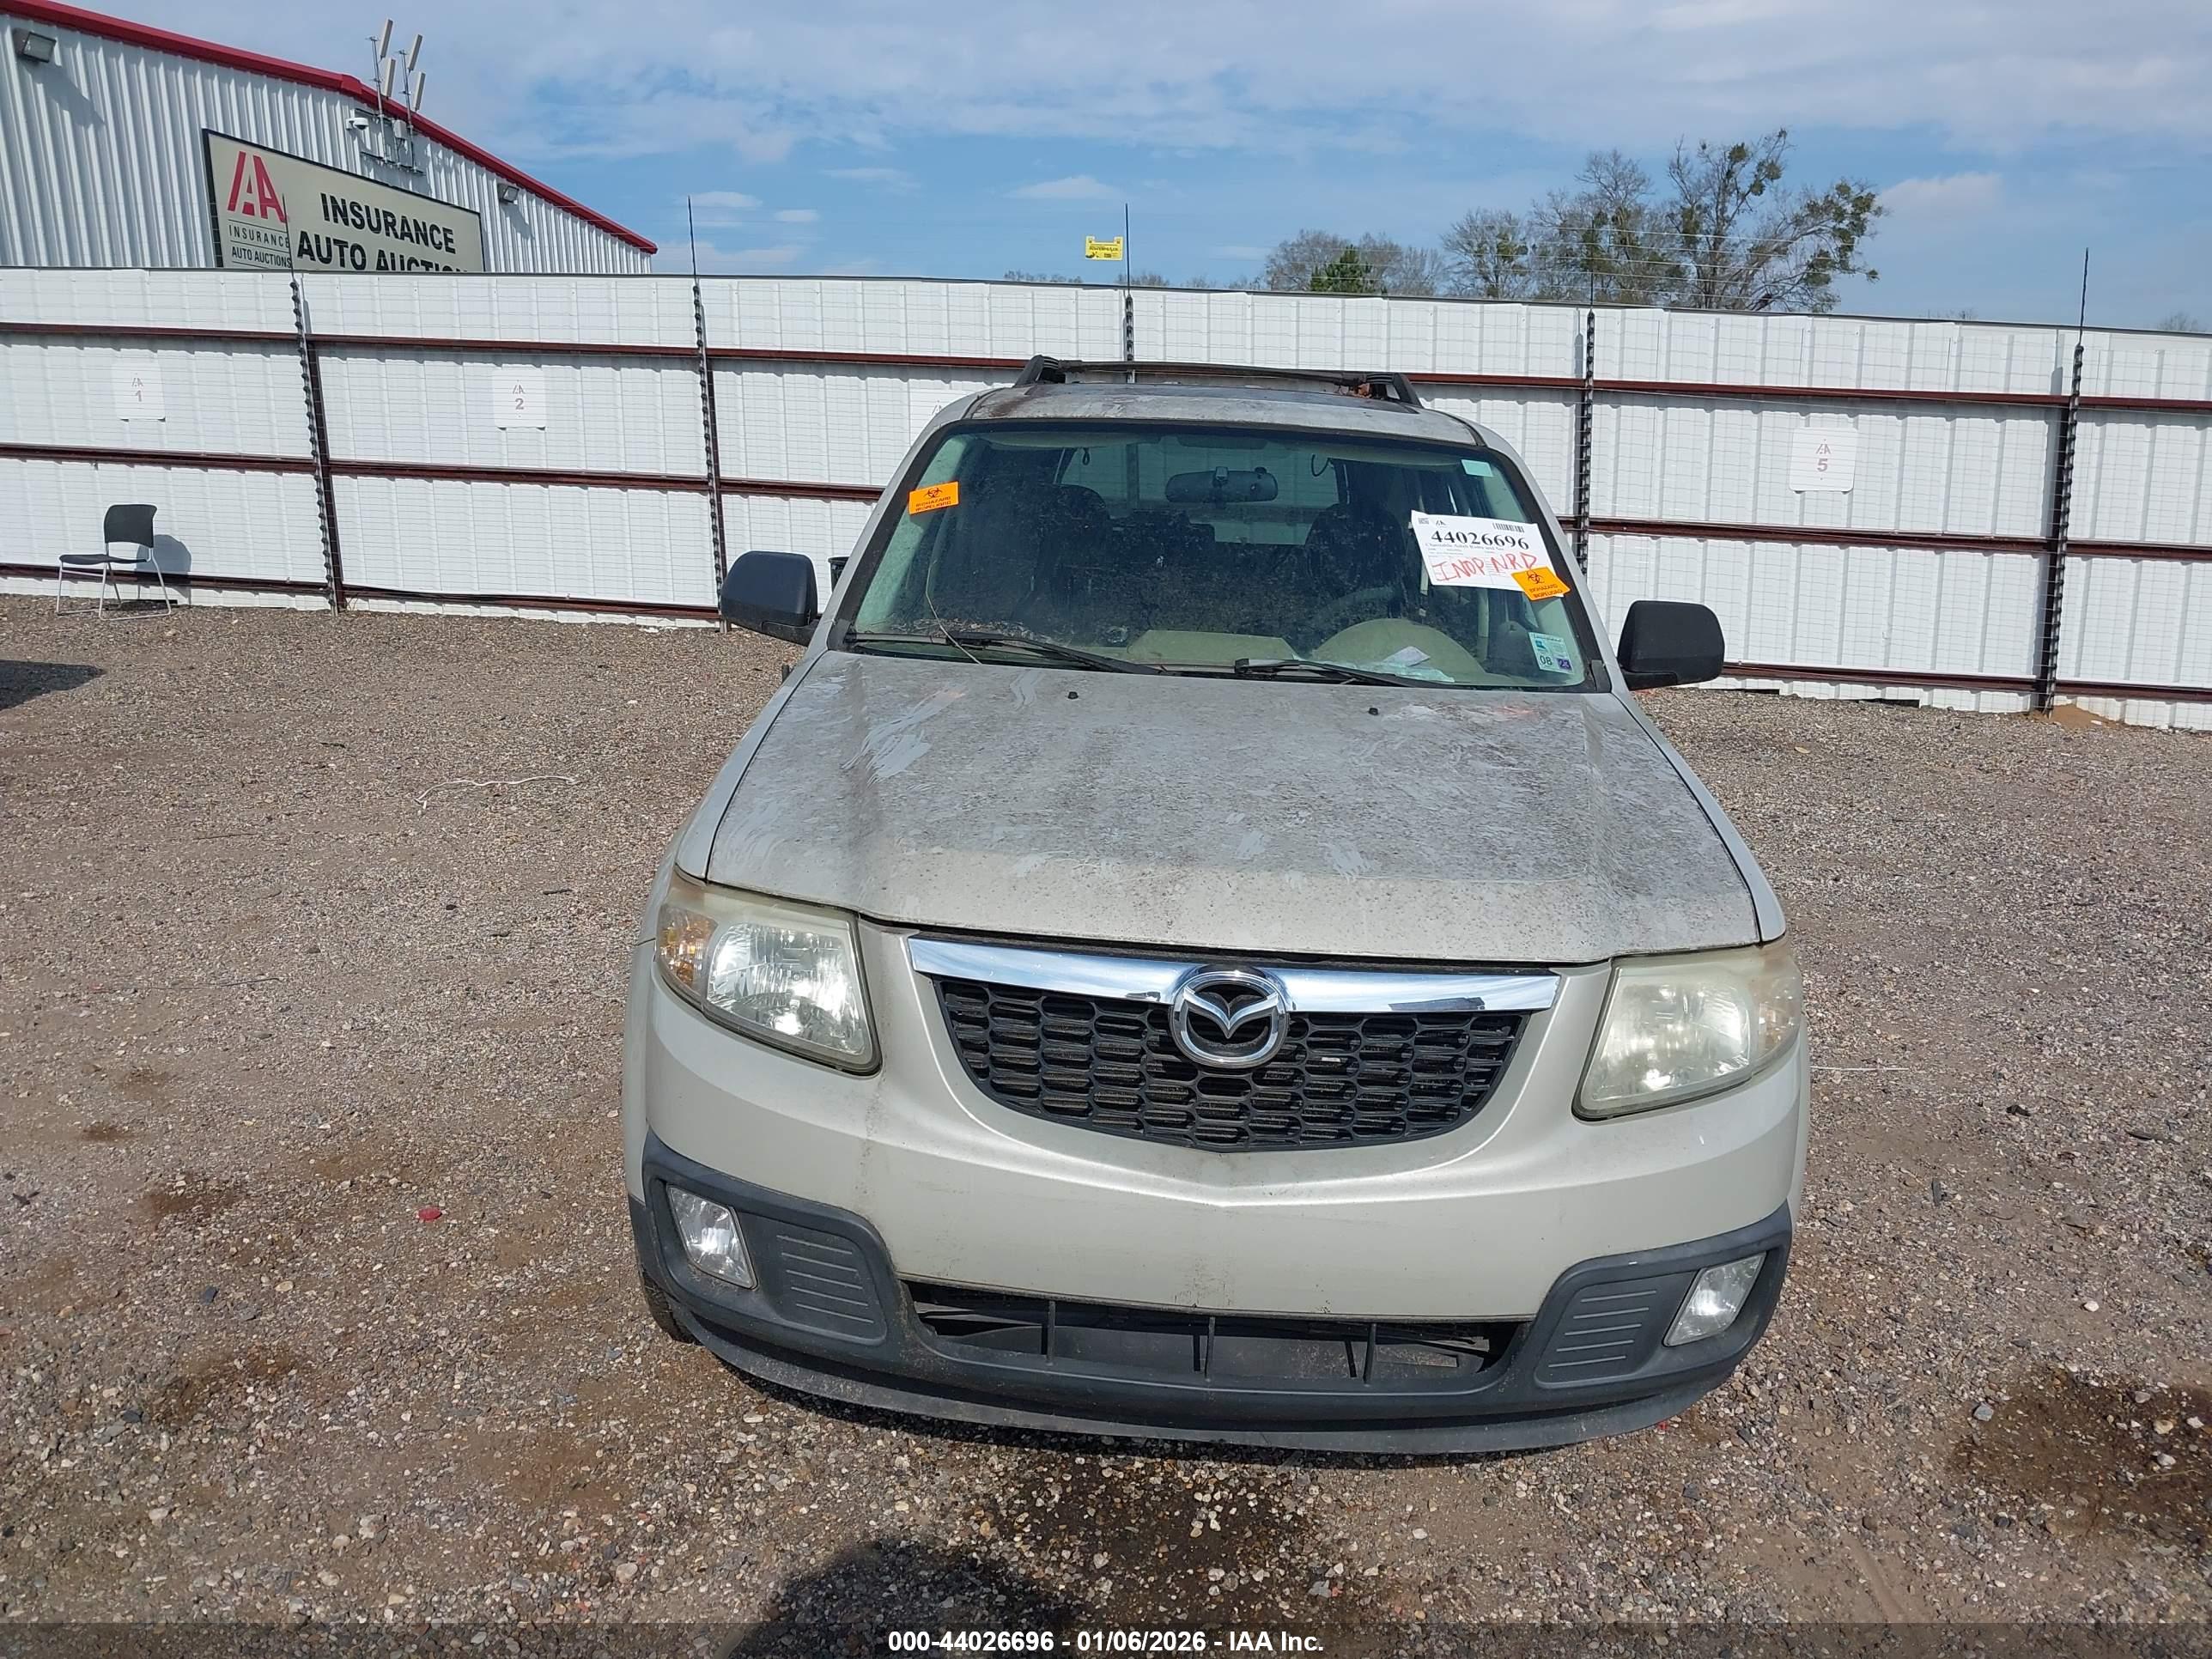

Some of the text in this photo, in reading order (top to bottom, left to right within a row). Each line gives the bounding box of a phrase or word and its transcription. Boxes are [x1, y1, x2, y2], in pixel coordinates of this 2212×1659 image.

[320, 192, 457, 254] INSURANCE
[228, 224, 289, 248] INSURANCE
[232, 246, 292, 269] AUTO AUCTIONS
[297, 231, 367, 271] AUTO
[135, 390, 143, 402] 1
[514, 398, 525, 410] 2
[1816, 458, 1829, 472] 5
[1431, 531, 1529, 550] 44026696
[1431, 556, 1486, 581] INOP
[1539, 655, 1553, 665] 08
